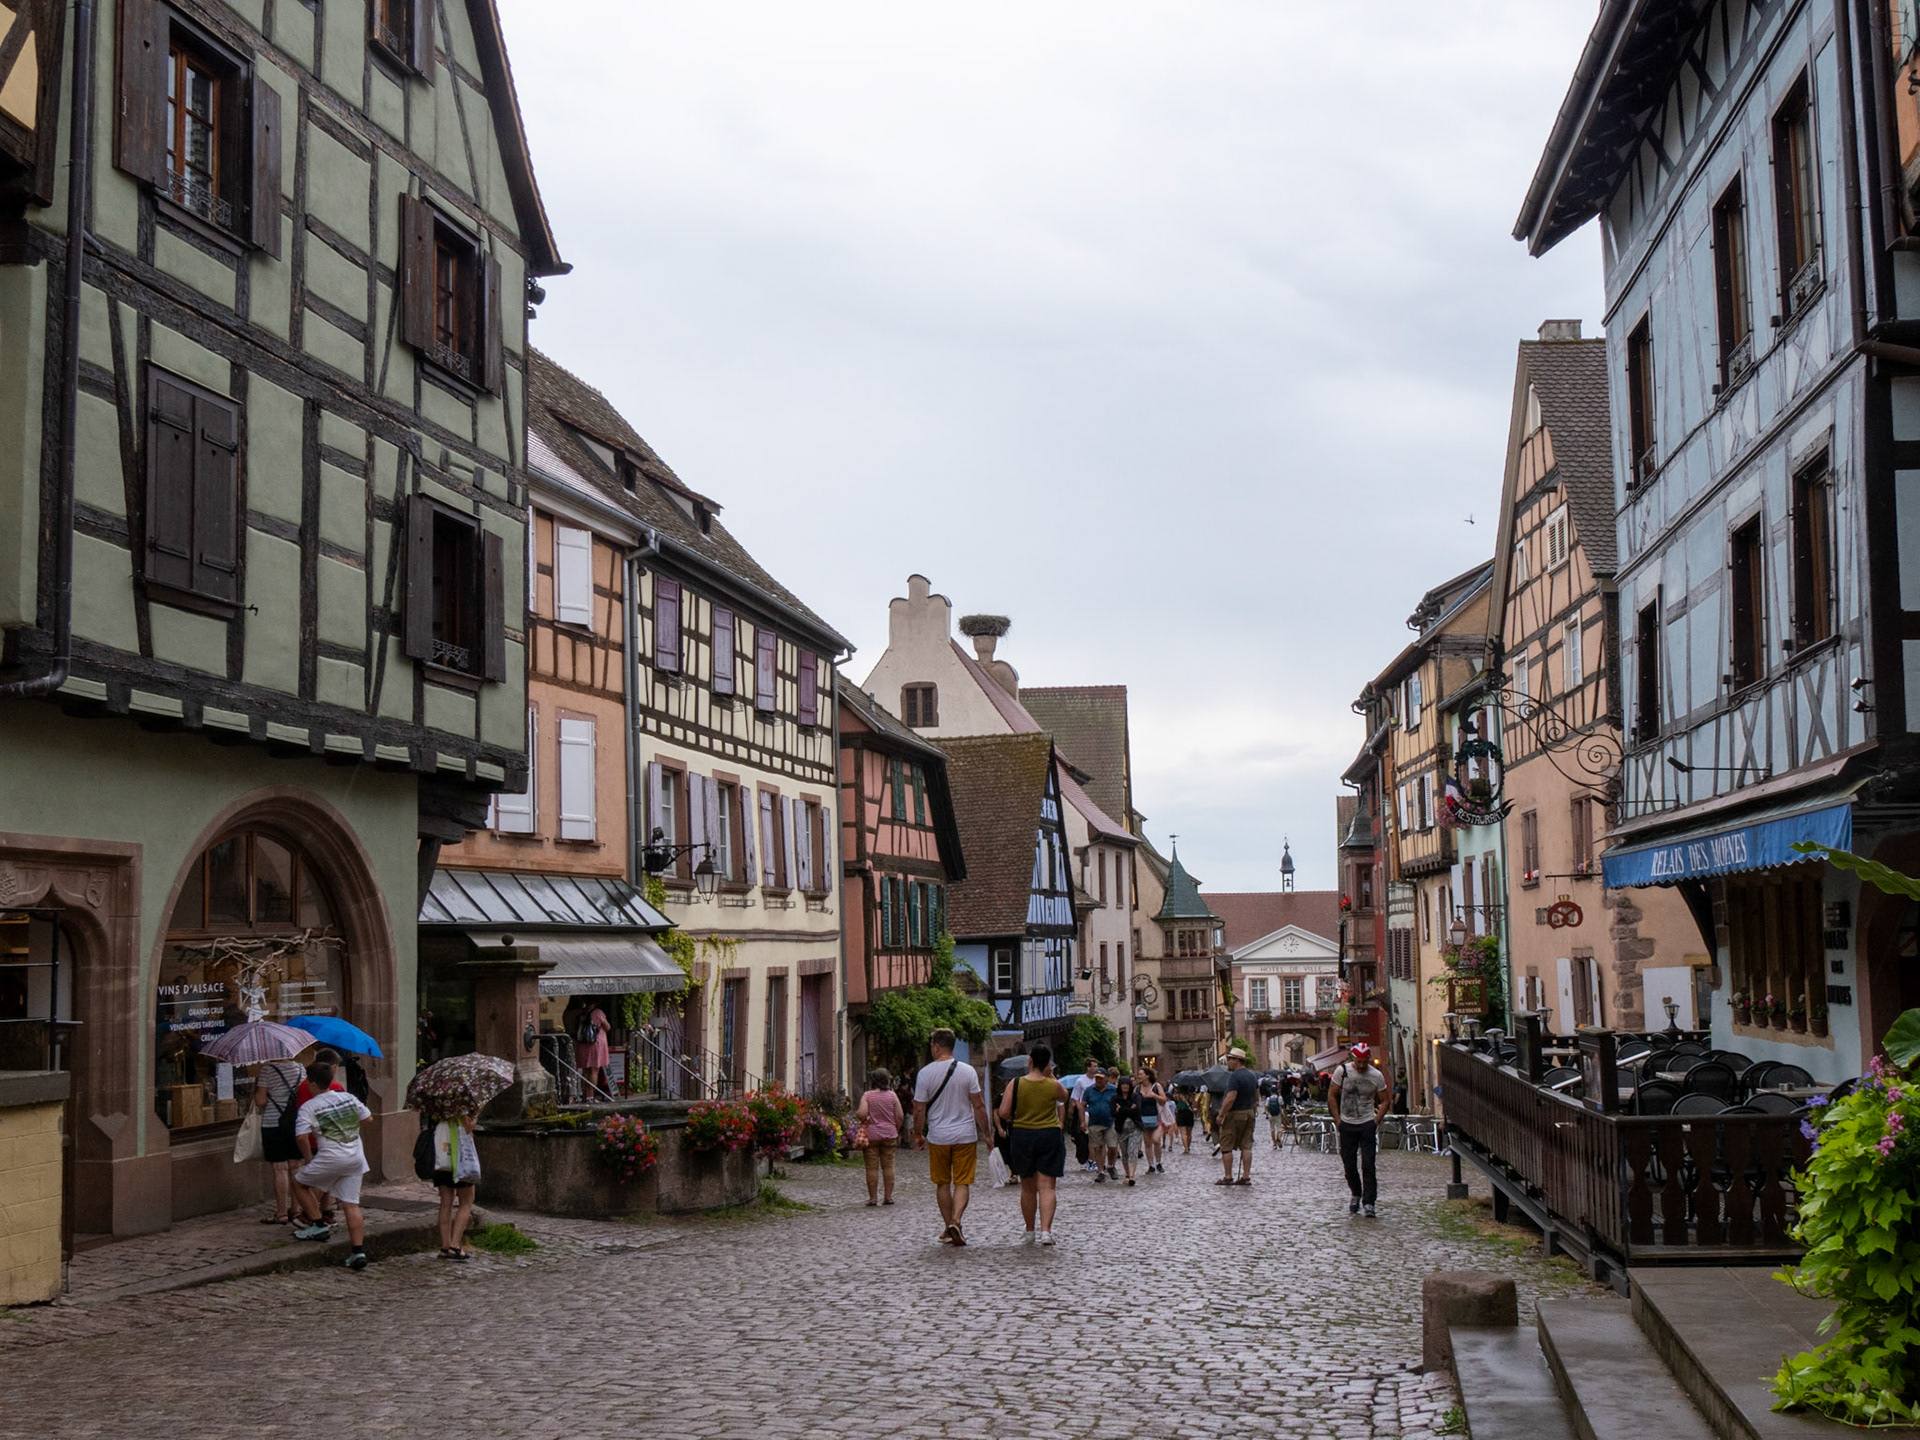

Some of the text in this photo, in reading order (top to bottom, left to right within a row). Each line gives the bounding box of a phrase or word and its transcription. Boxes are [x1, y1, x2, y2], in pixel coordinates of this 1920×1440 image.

[1455, 808, 1505, 825] RESTAURANT
[1651, 832, 1748, 876] RELAIS DES MOINES
[158, 982, 225, 996] VINS D'ALSACE
[188, 1006, 224, 1016] GRANDS CRUS
[169, 1019, 225, 1031] VENDANGES TARDIVES
